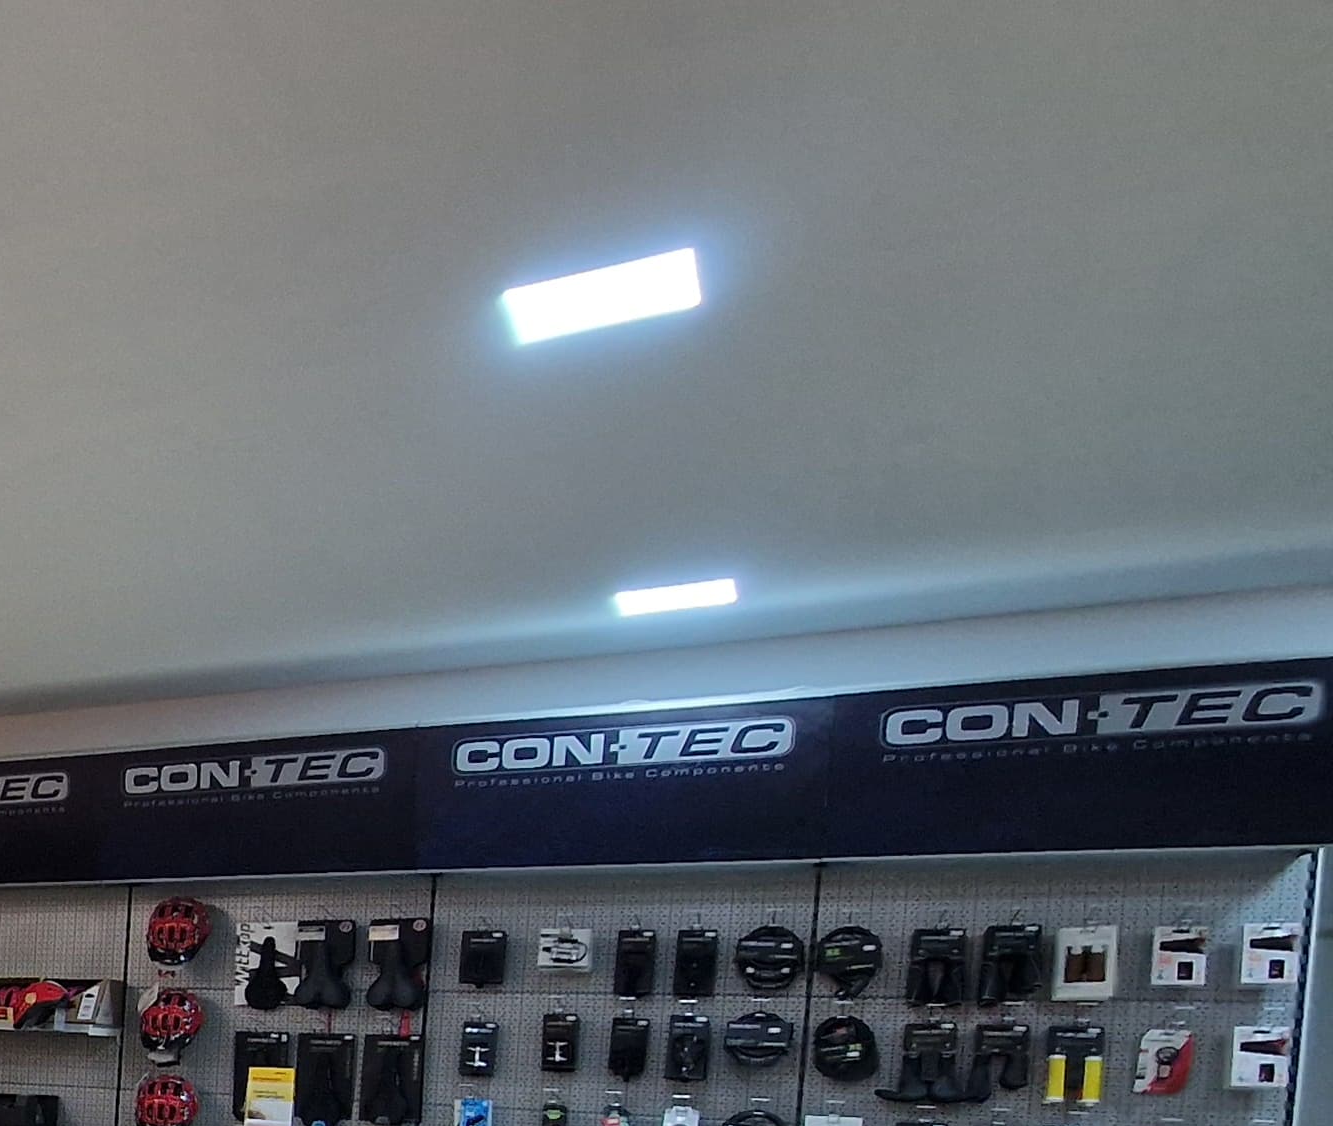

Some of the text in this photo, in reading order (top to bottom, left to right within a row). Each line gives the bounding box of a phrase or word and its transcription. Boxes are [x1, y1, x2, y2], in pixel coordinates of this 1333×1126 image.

[882, 733, 1314, 763] Professional Bike Components
[454, 762, 786, 788] Professional Bike Components
[124, 786, 380, 808] Professional Bike Components
